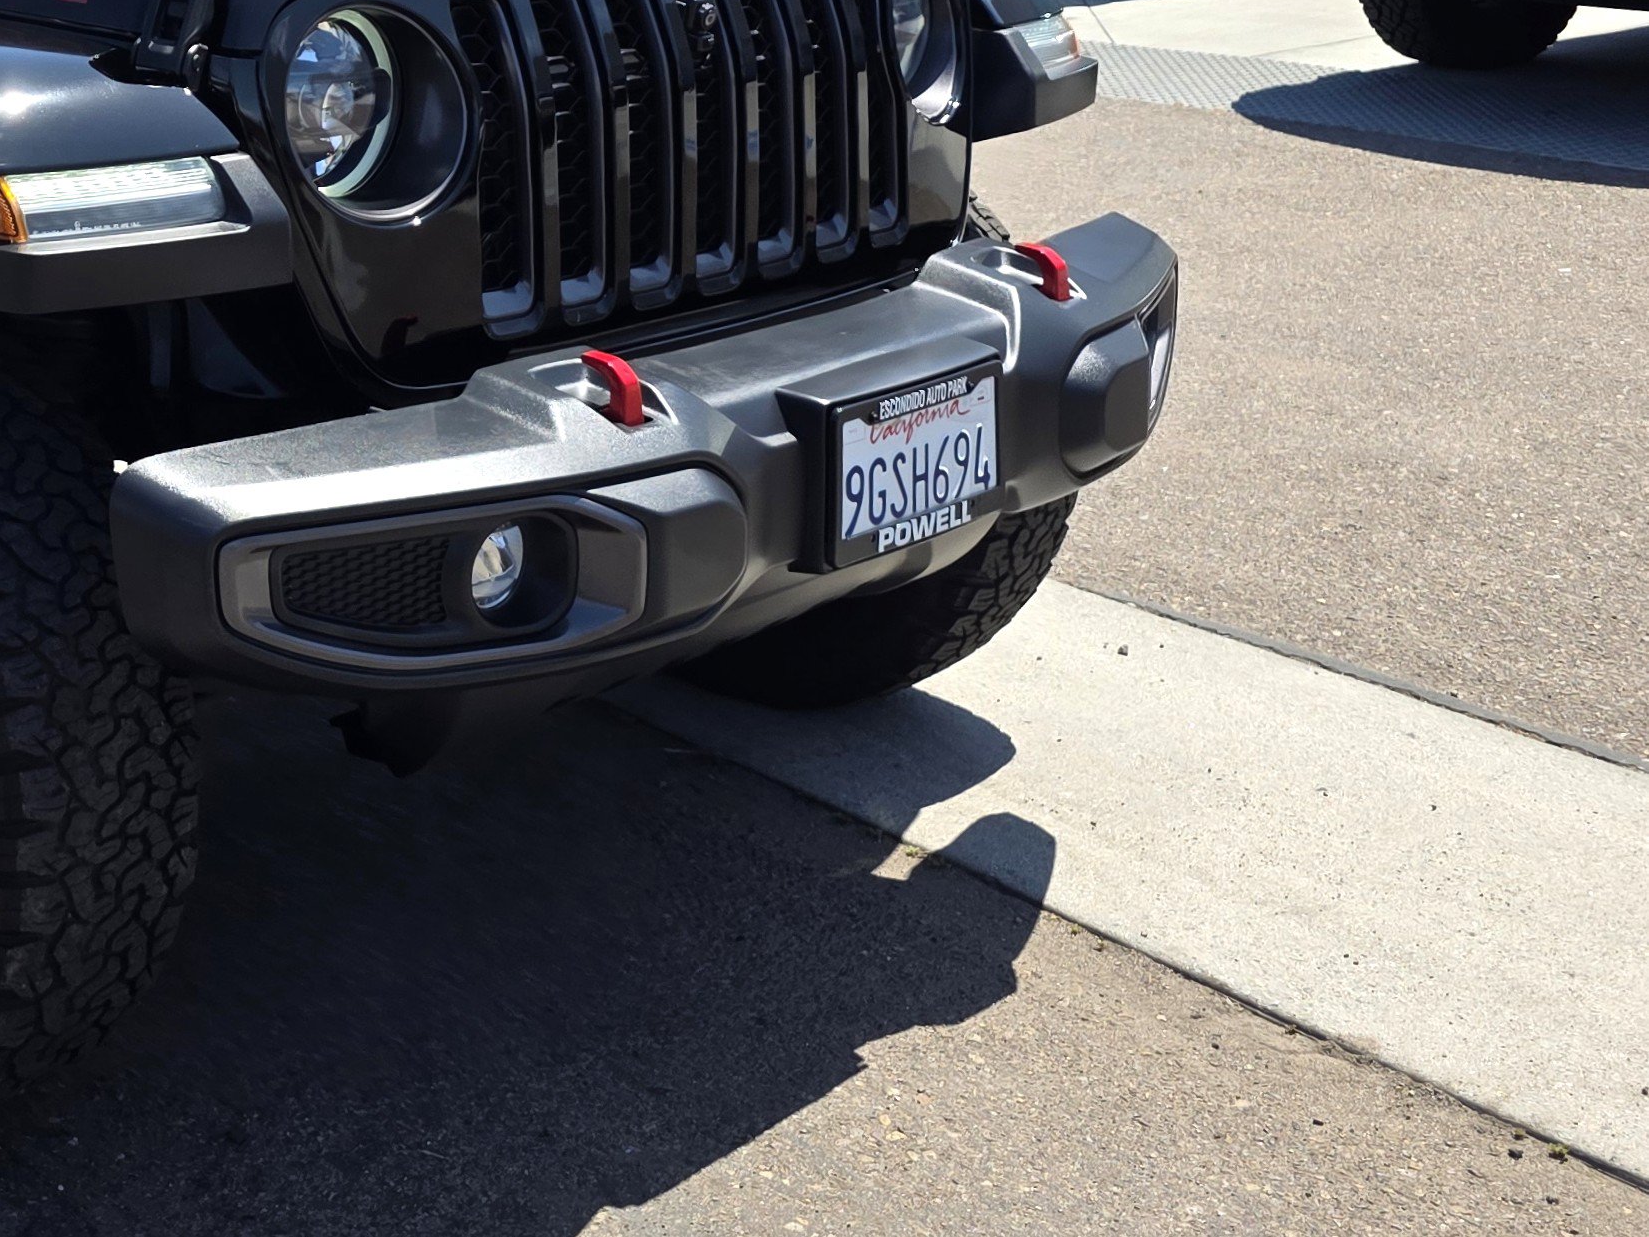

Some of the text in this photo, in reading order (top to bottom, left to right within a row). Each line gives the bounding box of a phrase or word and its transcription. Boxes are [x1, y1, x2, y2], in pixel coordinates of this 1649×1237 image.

[879, 376, 968, 421] ESCONDIDO AUTO PARK
[845, 422, 991, 537] 9GSH694
[878, 501, 972, 553] POWELL
